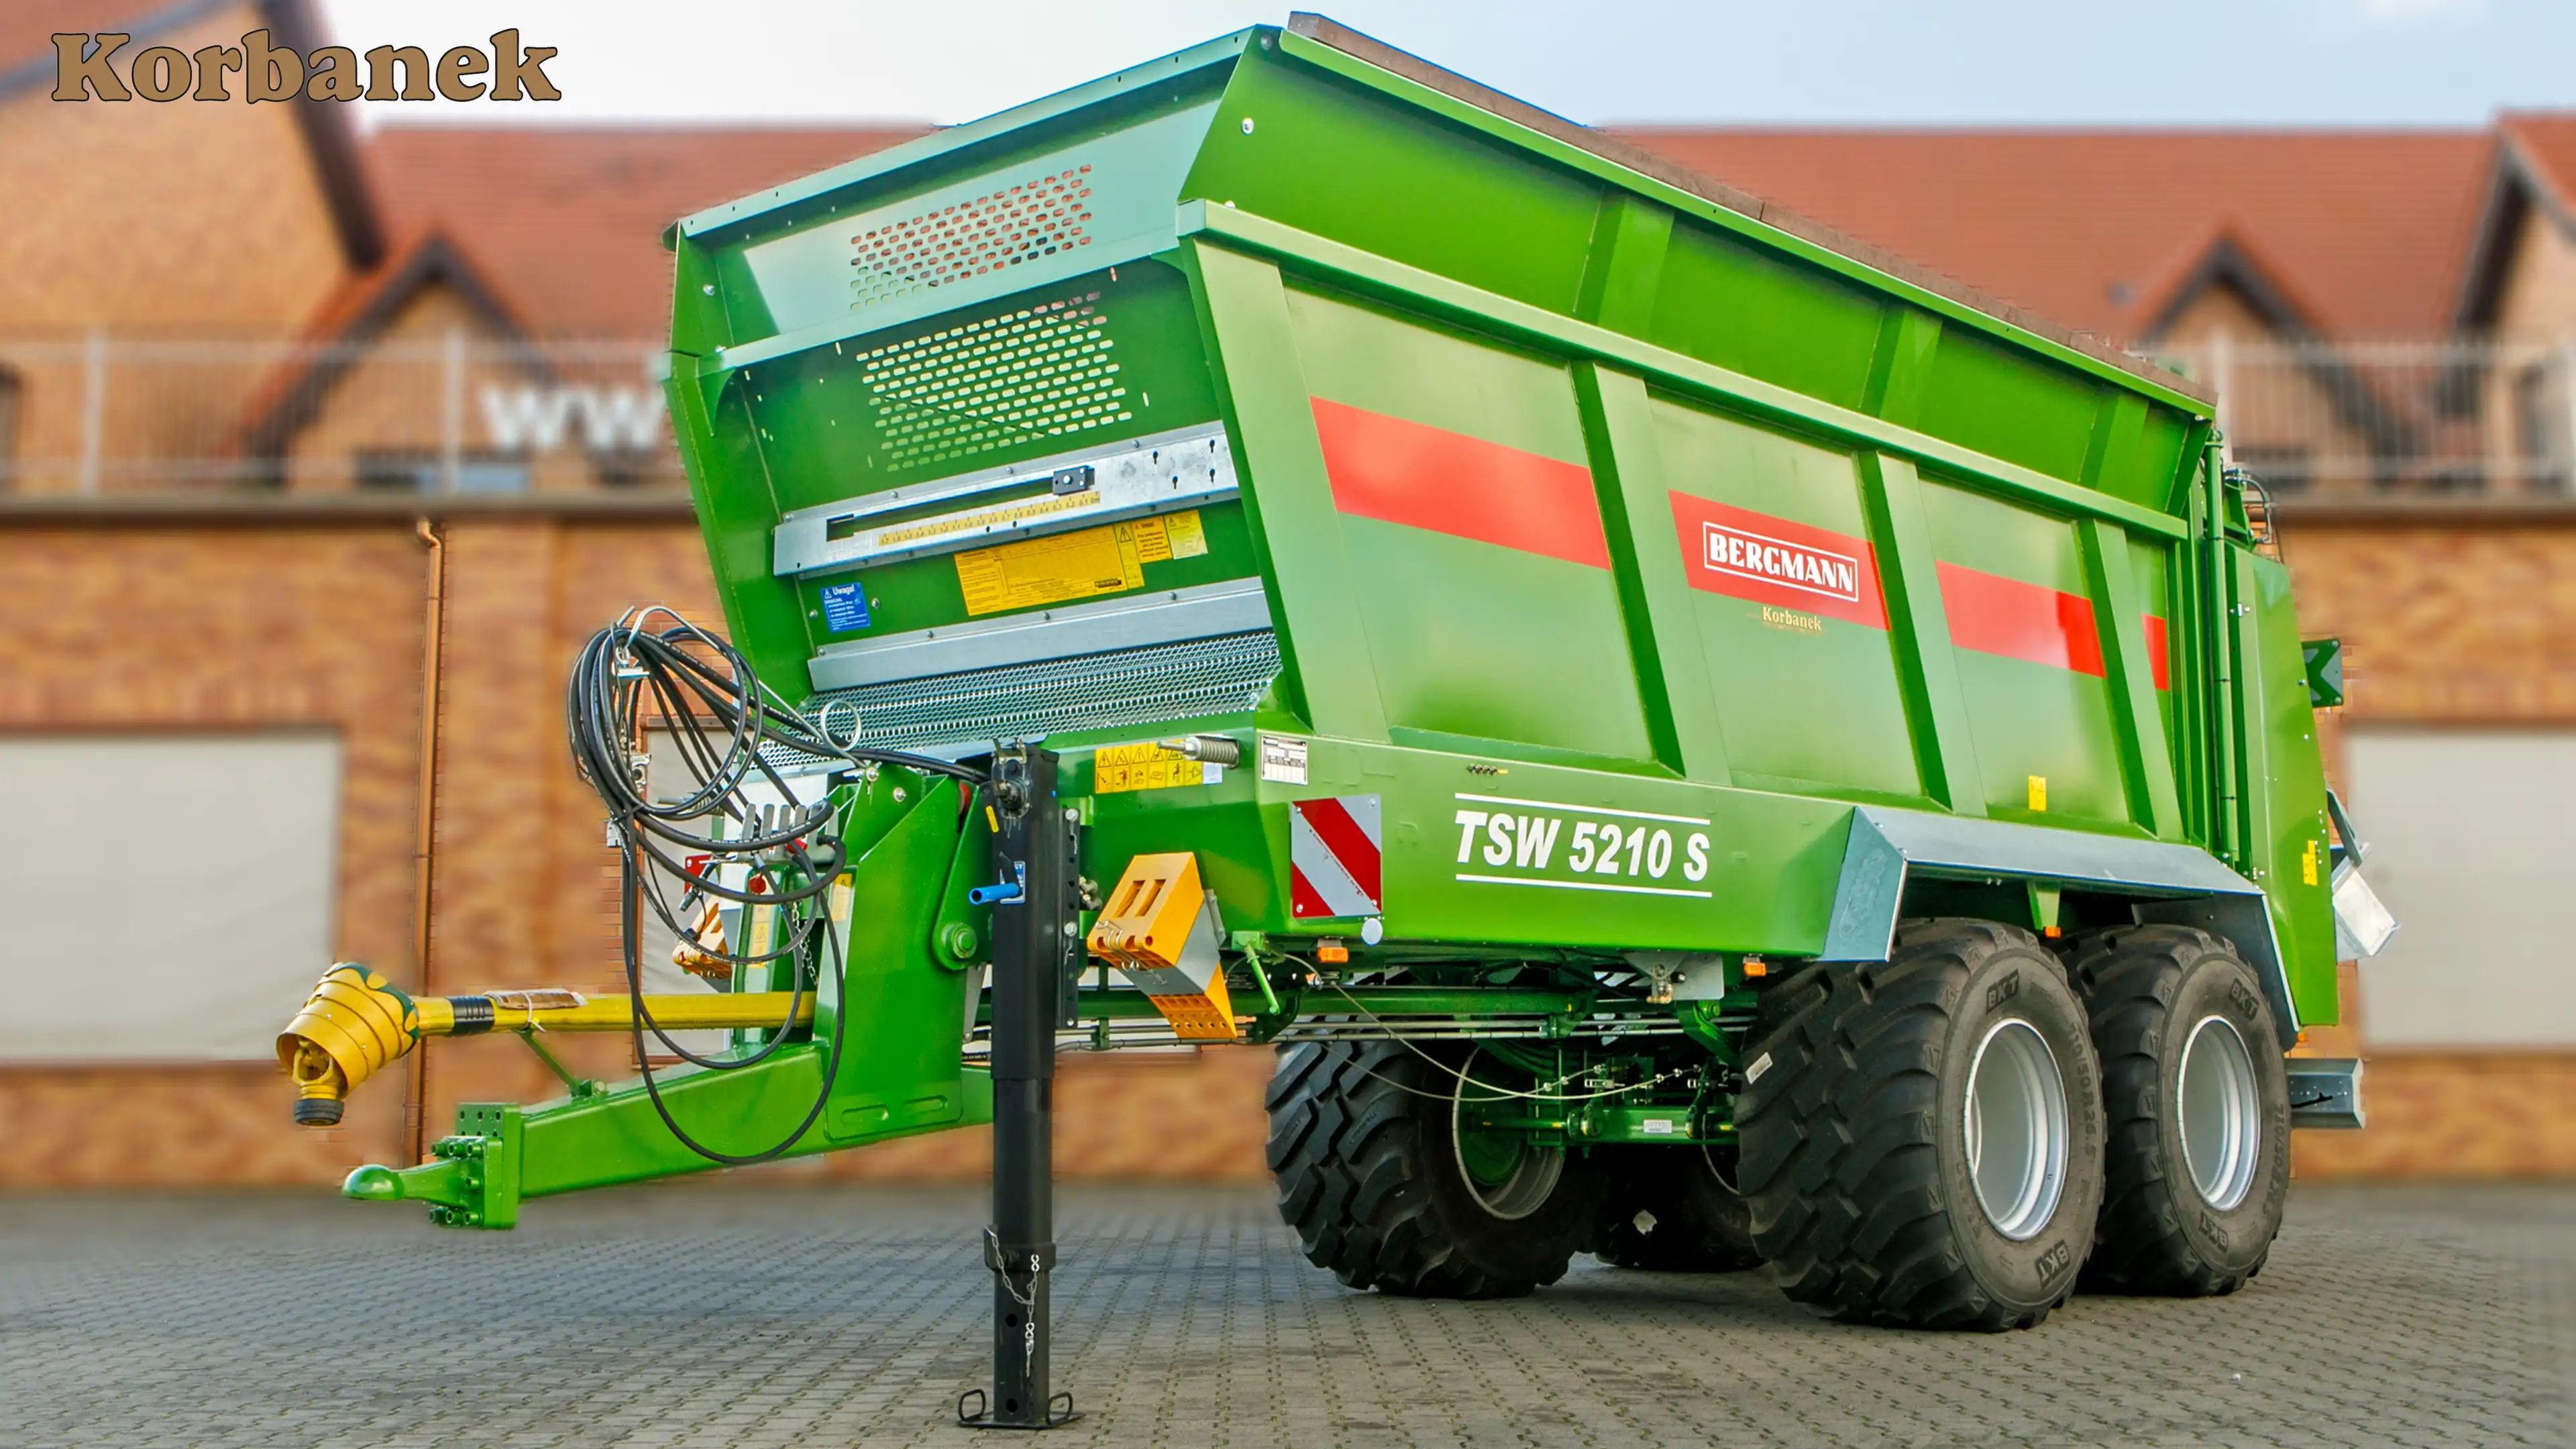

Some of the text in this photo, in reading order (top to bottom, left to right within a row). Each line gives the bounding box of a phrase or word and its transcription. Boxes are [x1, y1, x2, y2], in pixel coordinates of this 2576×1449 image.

[1710, 532, 1854, 593] BERGMANN
[1762, 606, 1822, 631] Korbanek
[1455, 809, 1711, 882] TSW 5210 S
[1987, 973, 2018, 1011] BKT
[2231, 980, 2259, 1017] BKT
[2201, 1213, 2228, 1248] BKT
[2037, 1243, 2070, 1285] BKT
